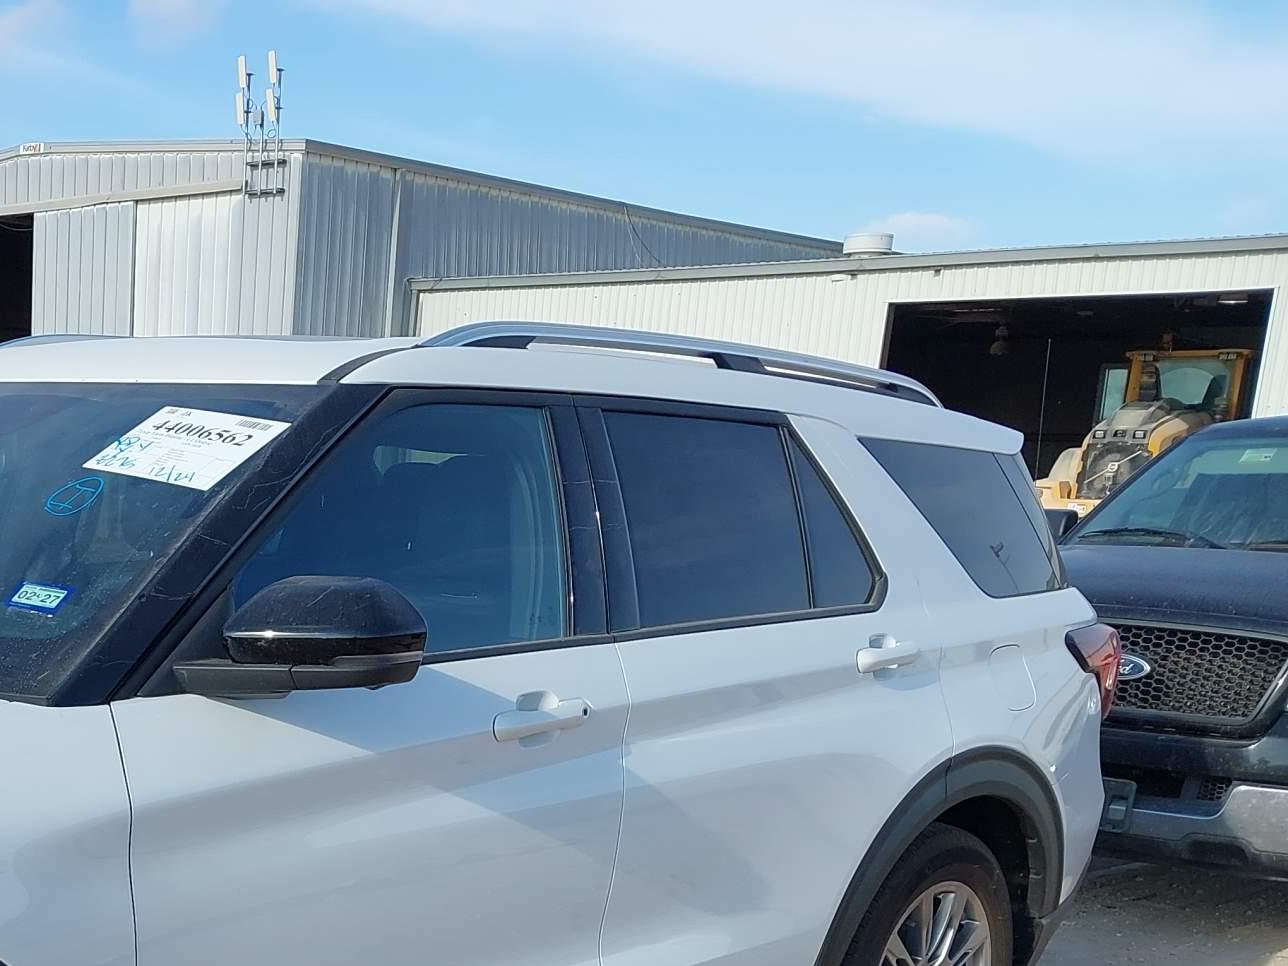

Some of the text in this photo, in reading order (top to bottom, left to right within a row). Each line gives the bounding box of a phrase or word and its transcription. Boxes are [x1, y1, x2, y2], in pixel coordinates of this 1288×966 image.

[152, 419, 254, 447] 44006562
[148, 464, 196, 483] 12/24
[17, 590, 61, 604] 02 27
